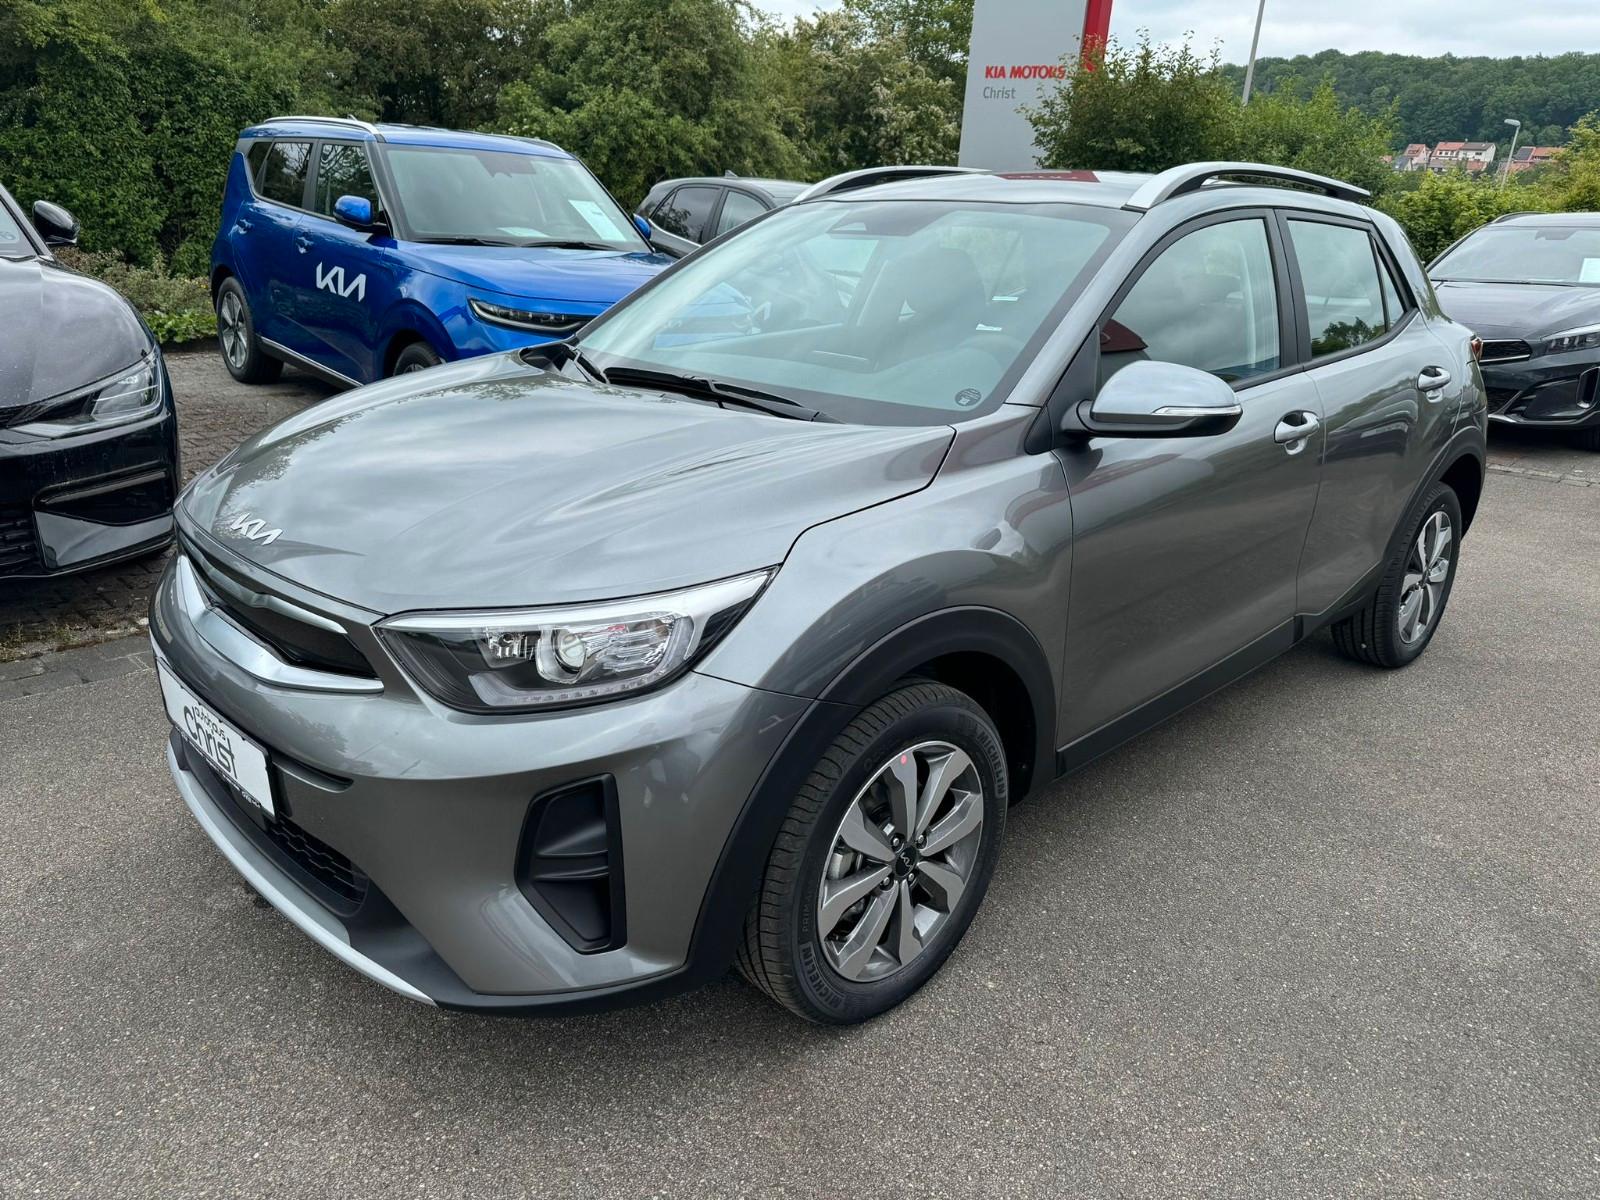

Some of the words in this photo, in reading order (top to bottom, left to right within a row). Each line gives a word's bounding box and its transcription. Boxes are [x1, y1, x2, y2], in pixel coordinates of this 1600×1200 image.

[983, 86, 1016, 99] Christ
[985, 66, 1006, 79] KIA
[316, 261, 367, 303] KIA
[230, 512, 283, 546] KIA
[183, 704, 239, 780] Christ
[975, 730, 1006, 795] MICHELIN
[801, 946, 843, 1009] MICHELIN
